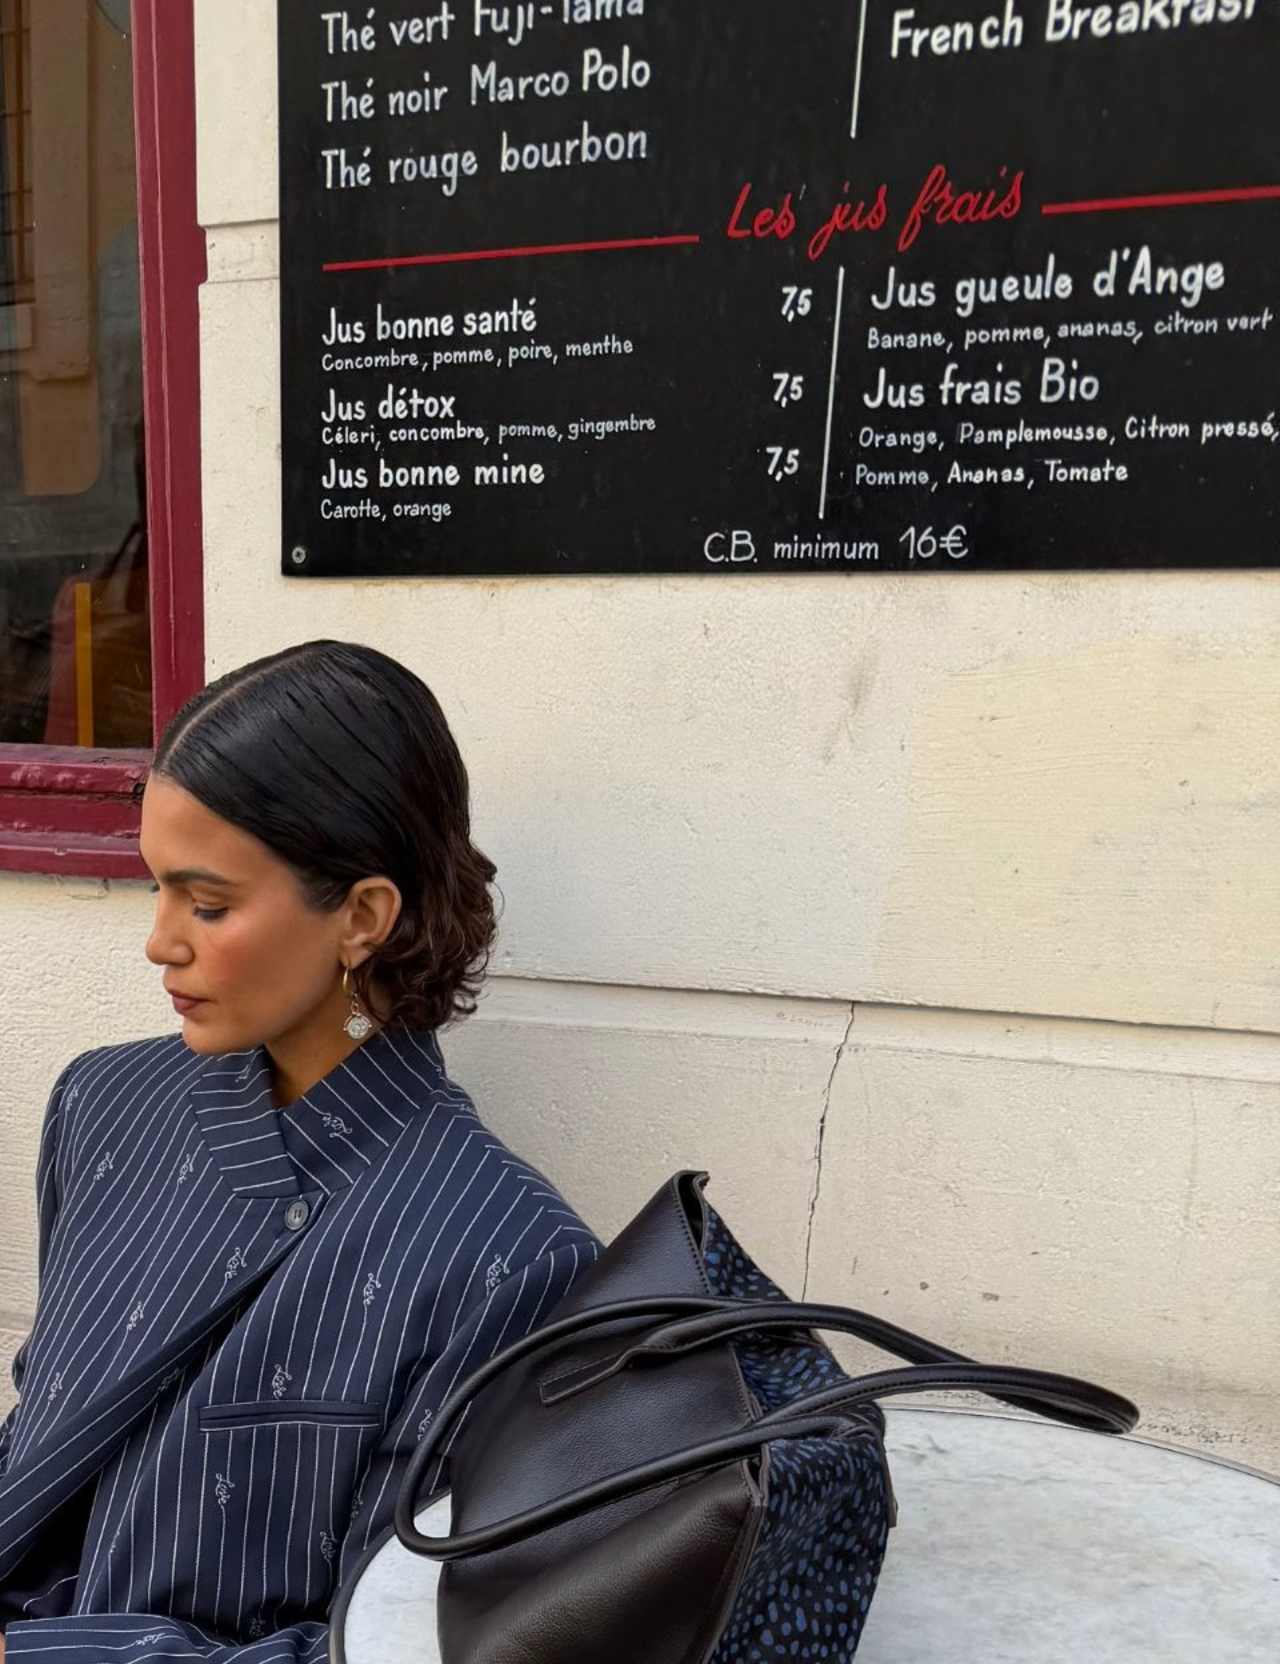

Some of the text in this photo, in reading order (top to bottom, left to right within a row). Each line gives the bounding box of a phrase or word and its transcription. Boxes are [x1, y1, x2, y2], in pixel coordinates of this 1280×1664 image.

[321, 8, 375, 54] Thé
[389, 1, 455, 45] vert
[891, 0, 1023, 58] French
[321, 45, 650, 122] Thé noir Marco Polo
[321, 121, 646, 196] Thé rouge bourbon
[727, 166, 1023, 260] Les jus frais
[871, 246, 1224, 317] Jus gueule d'Ange
[322, 298, 536, 345] Jus bonne santé
[1154, 311, 1217, 334] citron
[1227, 308, 1273, 330] vert
[322, 348, 428, 371] Concombre,
[566, 334, 633, 356] menthe
[864, 358, 1099, 408] Jus frais Bio
[321, 384, 455, 423] Jus détox
[568, 414, 656, 440] gingembre
[1125, 416, 1189, 438] Citron
[322, 453, 544, 488] Jus bonne mine
[1045, 459, 1128, 482] Tomate
[393, 504, 451, 522] orange
[774, 534, 878, 559] minimum
[899, 525, 968, 558] 16€
